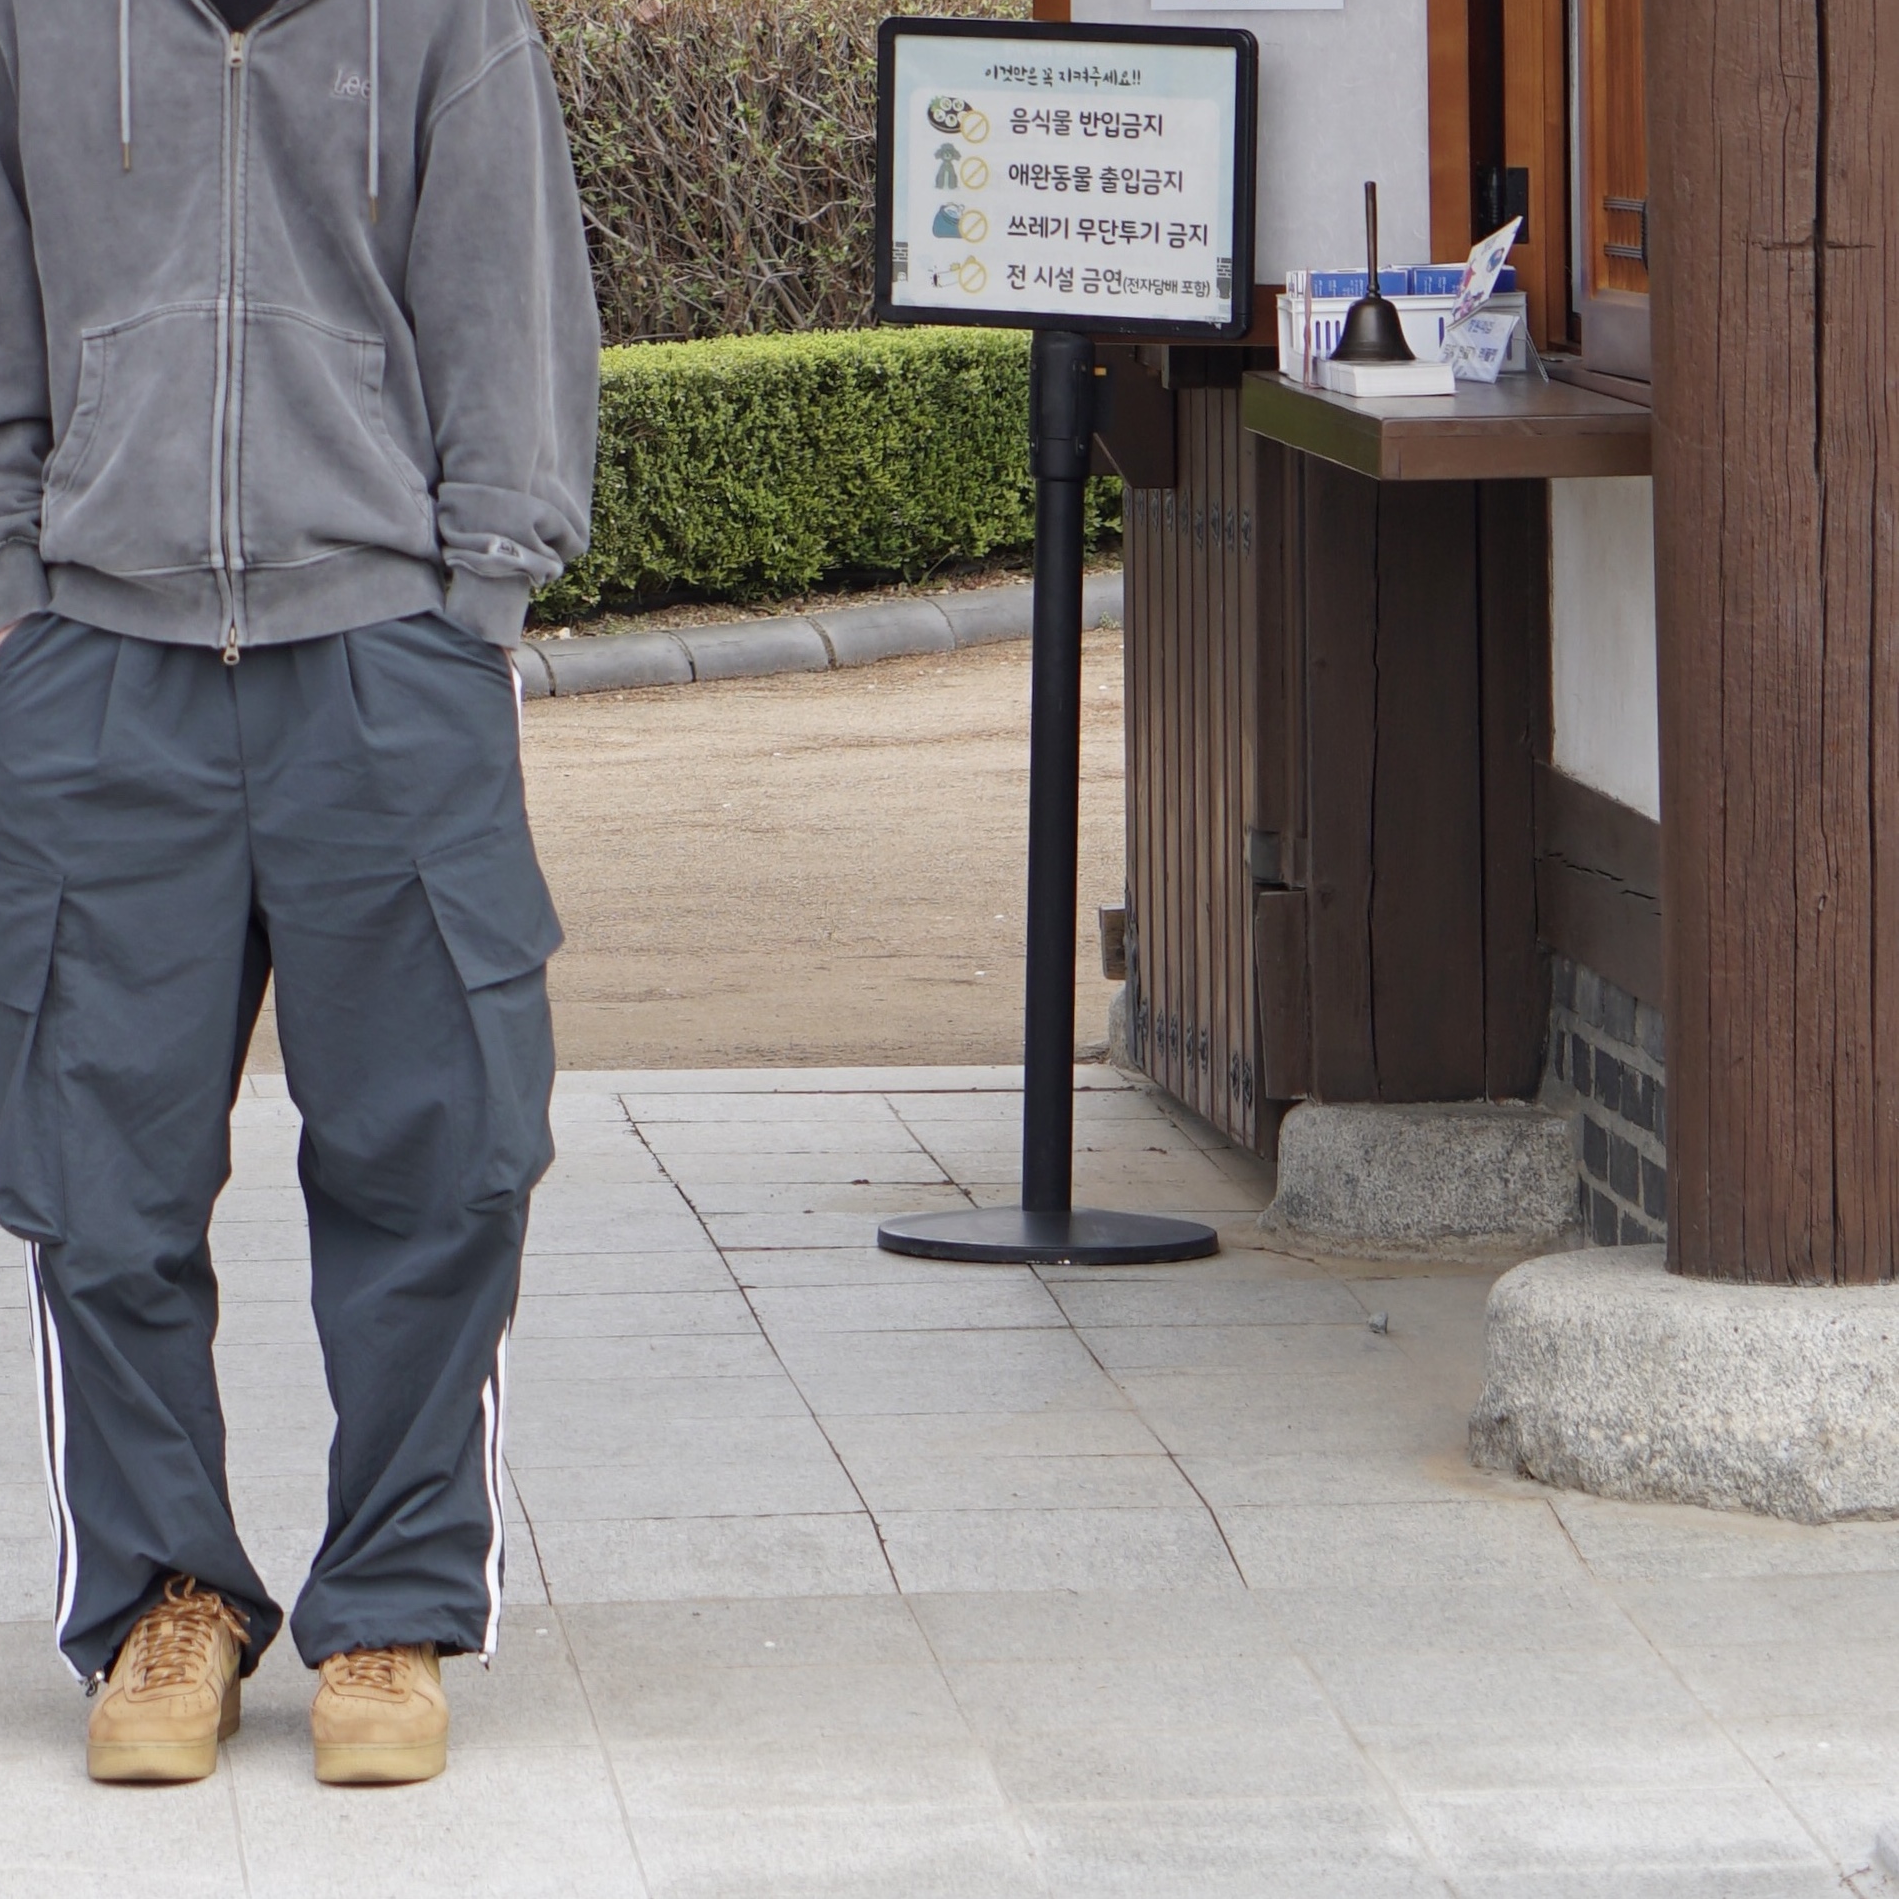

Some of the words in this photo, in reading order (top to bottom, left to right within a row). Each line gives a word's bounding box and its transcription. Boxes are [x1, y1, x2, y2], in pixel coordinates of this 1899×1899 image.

[985, 66, 1037, 86] 이것만은
[1010, 108, 1072, 136] 음식물
[1080, 112, 1162, 138] 반입금지
[1009, 164, 1093, 192] 애완동물
[1099, 166, 1182, 194] 출입금지
[1007, 216, 1068, 239] 쓰레기
[1076, 219, 1159, 245] 무단투기
[1167, 223, 1207, 248] 금지
[1007, 265, 1025, 290] 전
[1034, 266, 1073, 293] 시설
